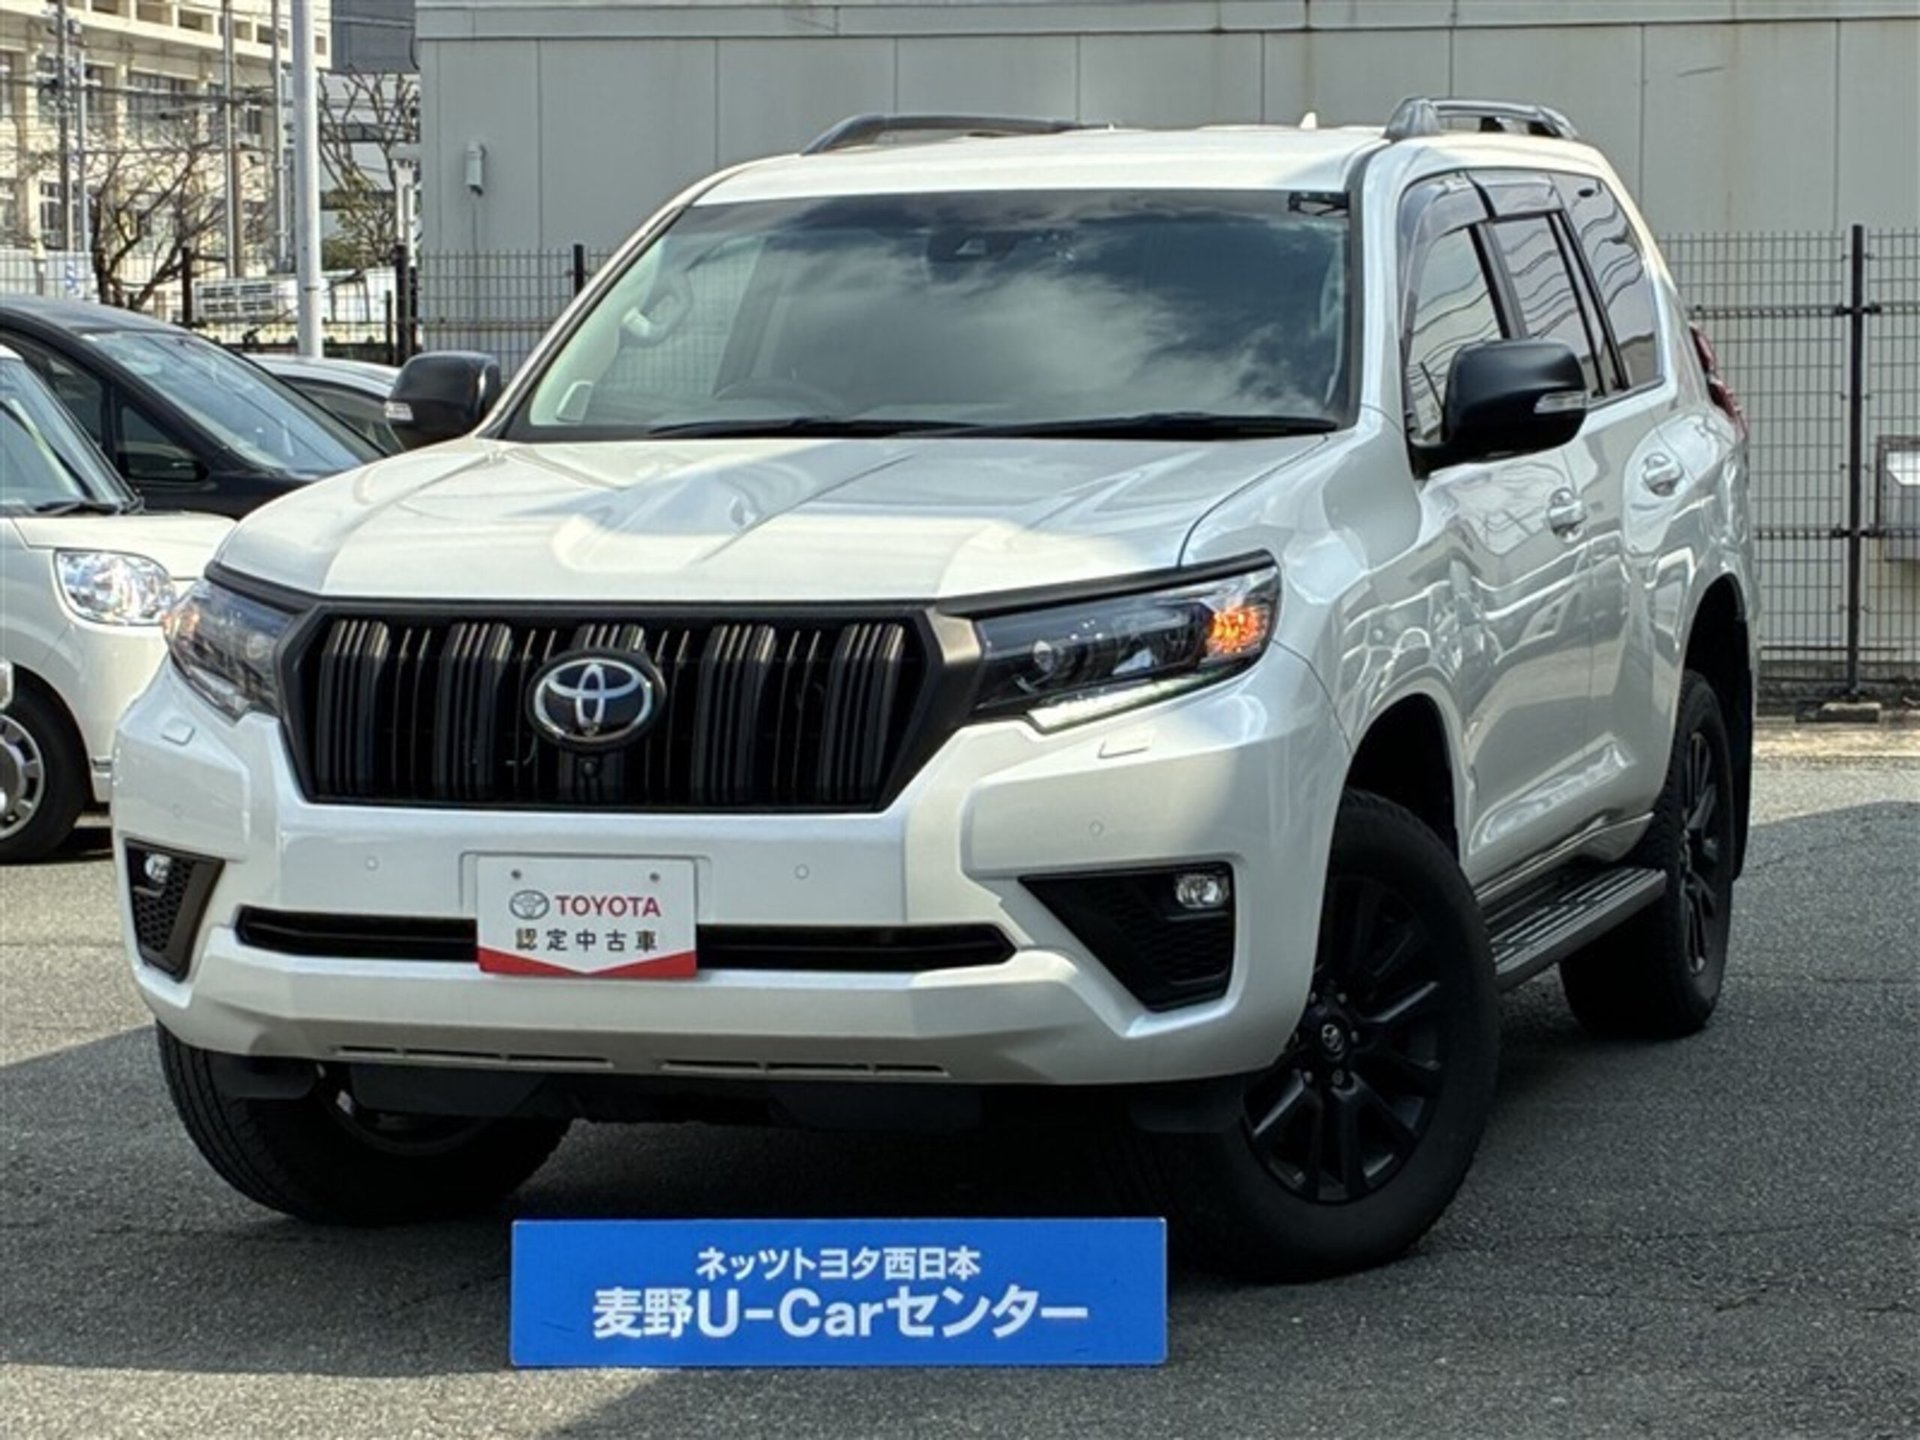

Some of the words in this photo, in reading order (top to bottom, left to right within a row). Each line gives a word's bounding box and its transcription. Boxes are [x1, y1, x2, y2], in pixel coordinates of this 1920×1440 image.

[555, 895, 661, 917] TOYOTA
[515, 928, 657, 952] 認定中古車
[697, 1246, 981, 1281] ネッツトヨタ西日本
